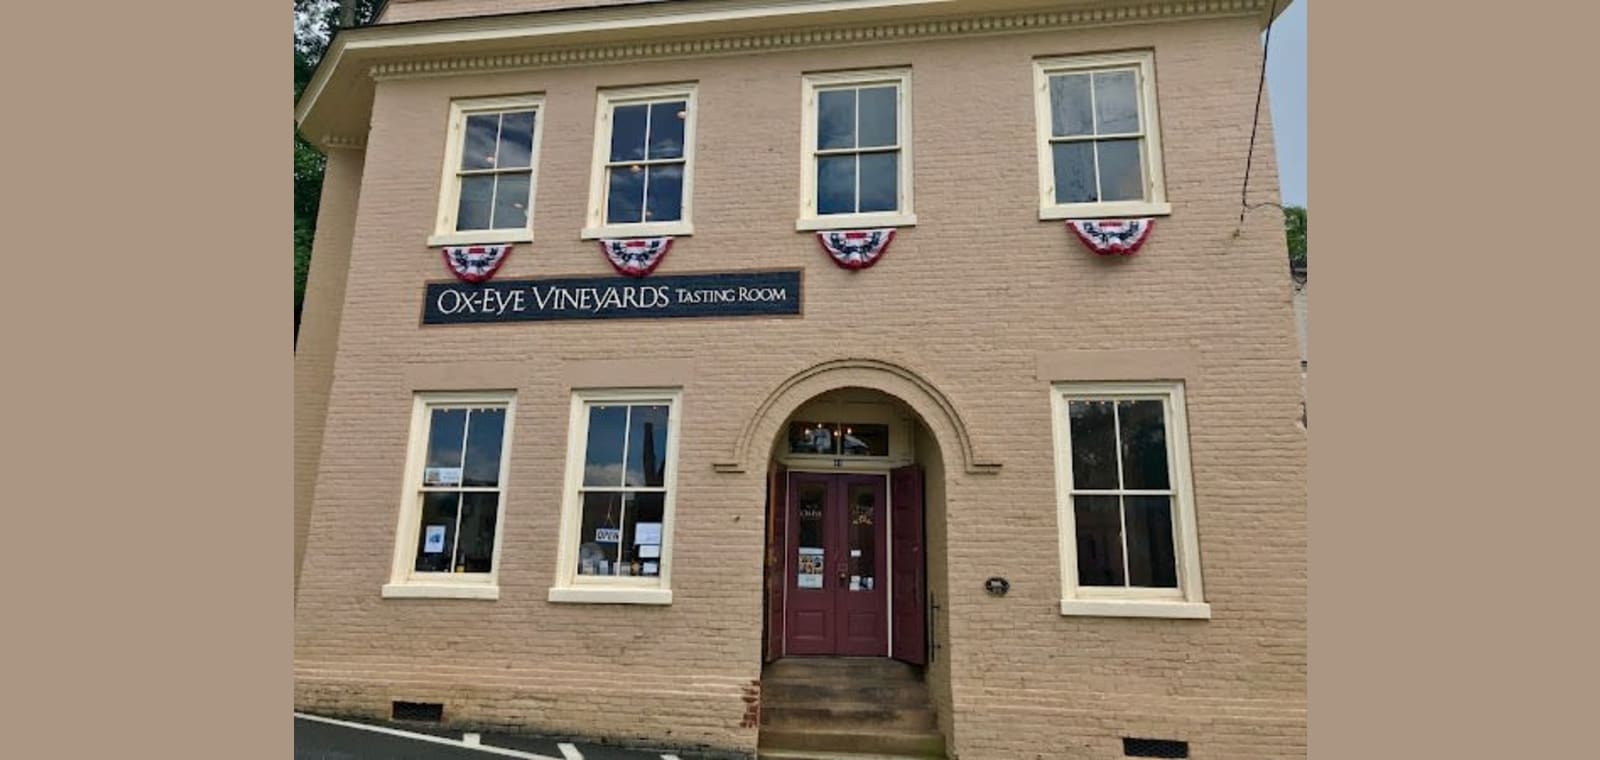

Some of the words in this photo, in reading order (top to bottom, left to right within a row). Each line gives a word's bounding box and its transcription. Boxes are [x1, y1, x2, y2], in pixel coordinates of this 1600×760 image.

[532, 285, 670, 312] VINEYARDS
[675, 287, 735, 303] TASTING
[738, 286, 787, 302] ROOM
[597, 530, 620, 541] OPEN
